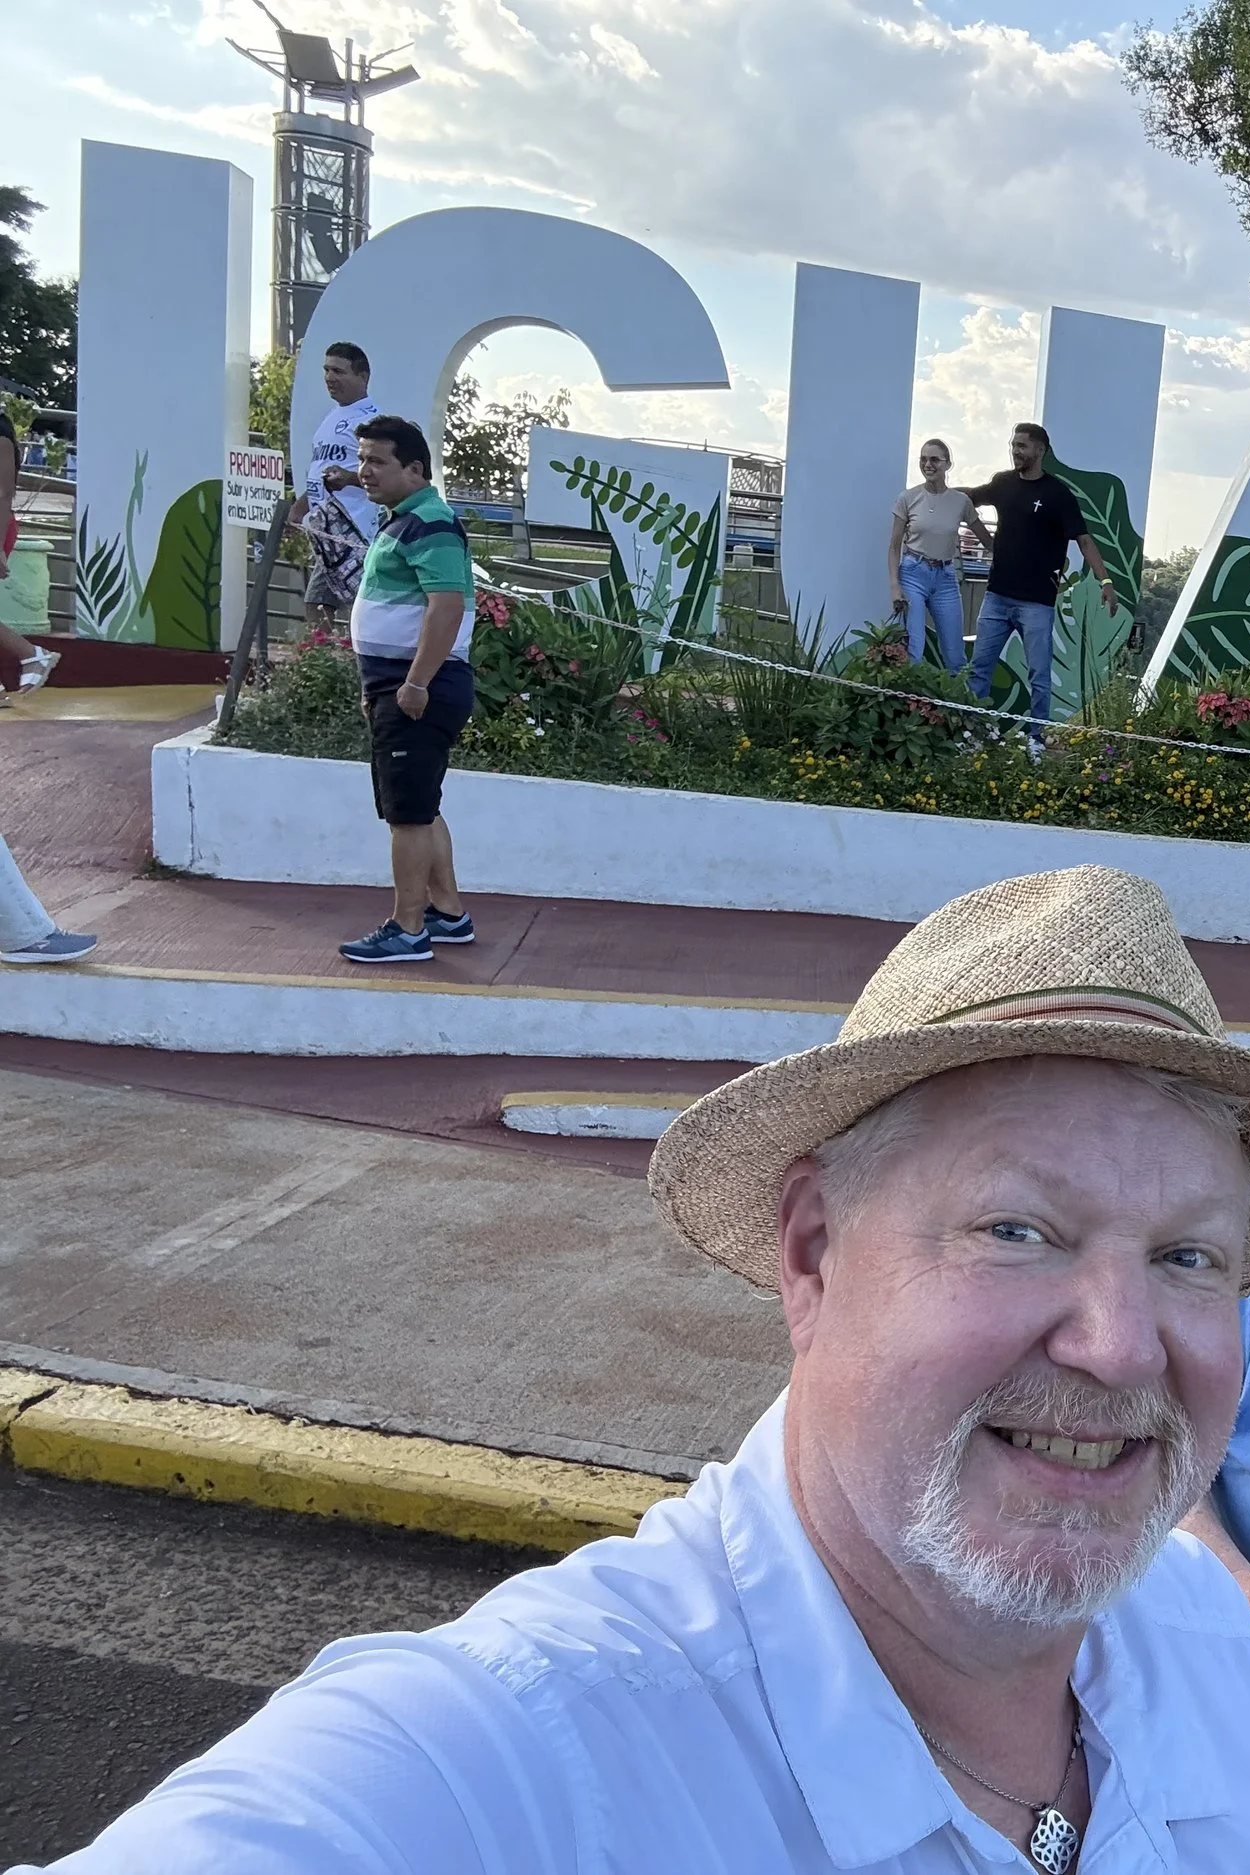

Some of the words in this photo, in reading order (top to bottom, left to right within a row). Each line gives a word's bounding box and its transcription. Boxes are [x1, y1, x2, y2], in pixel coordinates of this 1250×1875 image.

[230, 451, 284, 482] PROHIBIDO
[227, 480, 243, 497] Subir
[244, 486, 249, 502] y
[250, 484, 282, 502] sentarse
[228, 505, 237, 518] en
[237, 503, 247, 520] las
[248, 505, 273, 524] LETRAS
